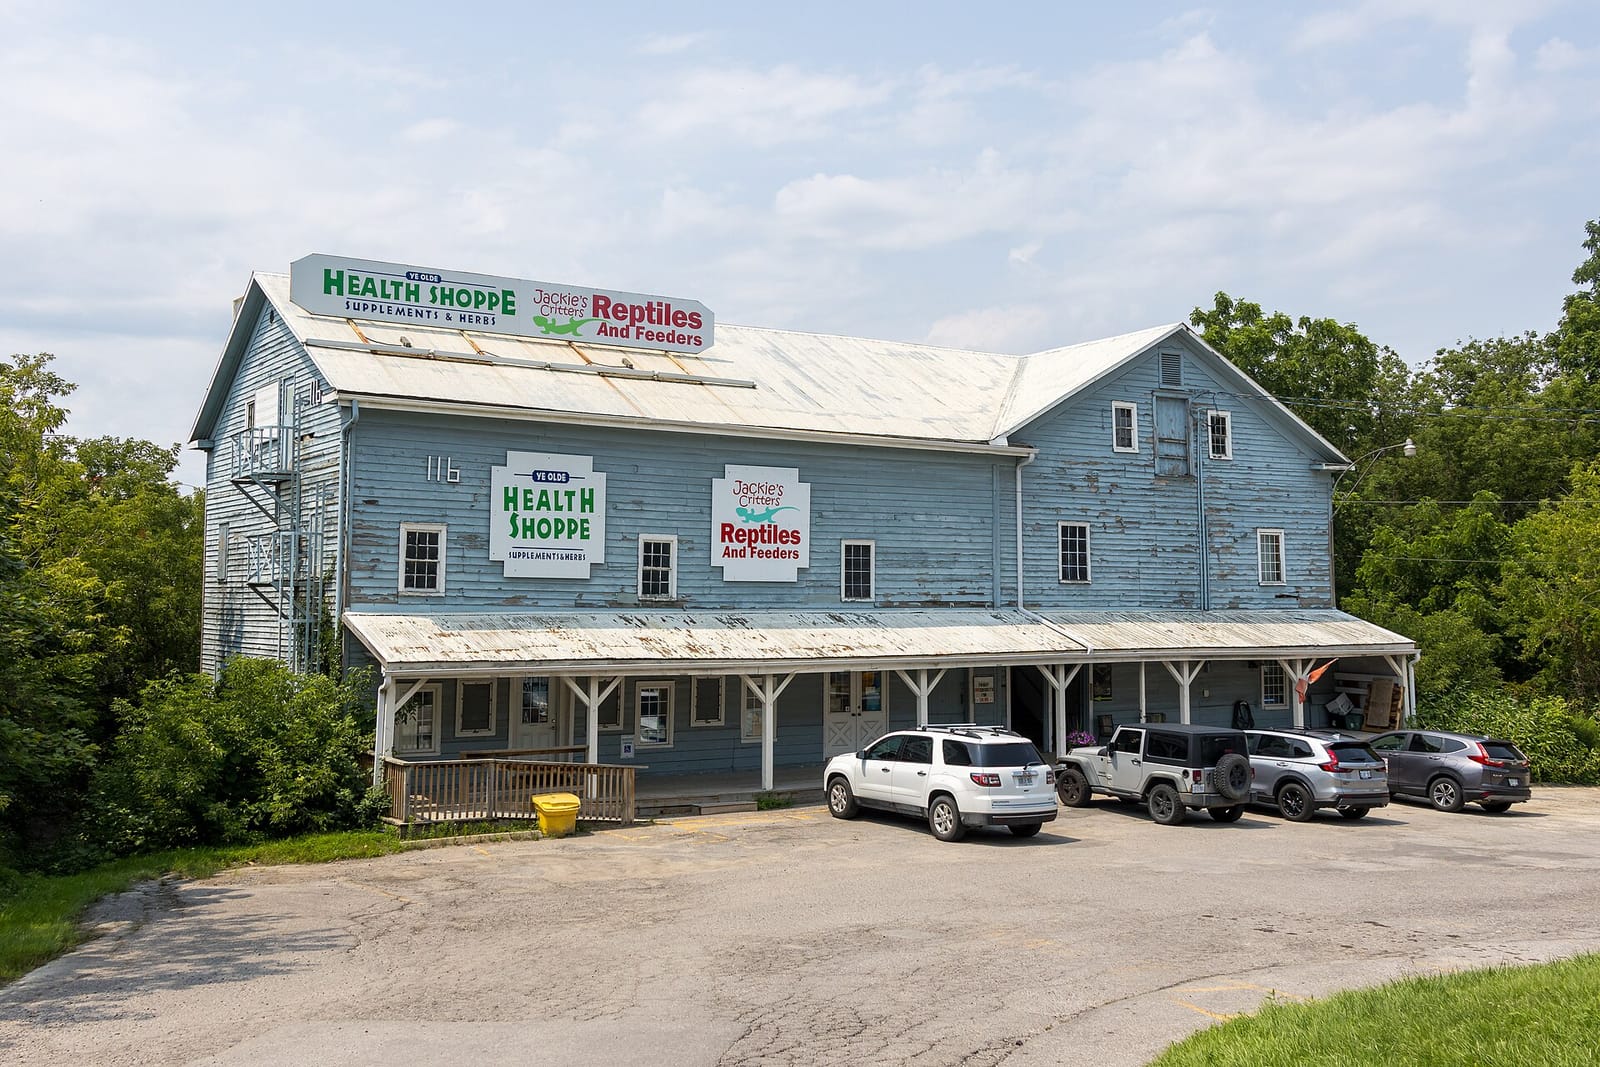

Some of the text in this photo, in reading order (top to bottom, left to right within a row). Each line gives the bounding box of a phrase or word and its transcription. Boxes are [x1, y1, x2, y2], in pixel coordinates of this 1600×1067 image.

[410, 272, 439, 283] YE OLDE
[323, 268, 516, 316] HEALTH SHOPPE
[533, 289, 588, 308] Jackie's
[345, 301, 496, 326] SUPPLEMENTS & HERBS
[540, 303, 585, 318] Critters
[592, 294, 703, 330] Reptiles
[596, 322, 703, 347] And Feeders
[536, 472, 567, 482] YE OLDE
[503, 486, 595, 513] HEALTH
[732, 480, 784, 497] Jackie's
[739, 495, 780, 507] Critters
[508, 512, 591, 540] SHOPPE
[720, 523, 801, 548] Reptiles
[722, 545, 799, 560] And Feeders
